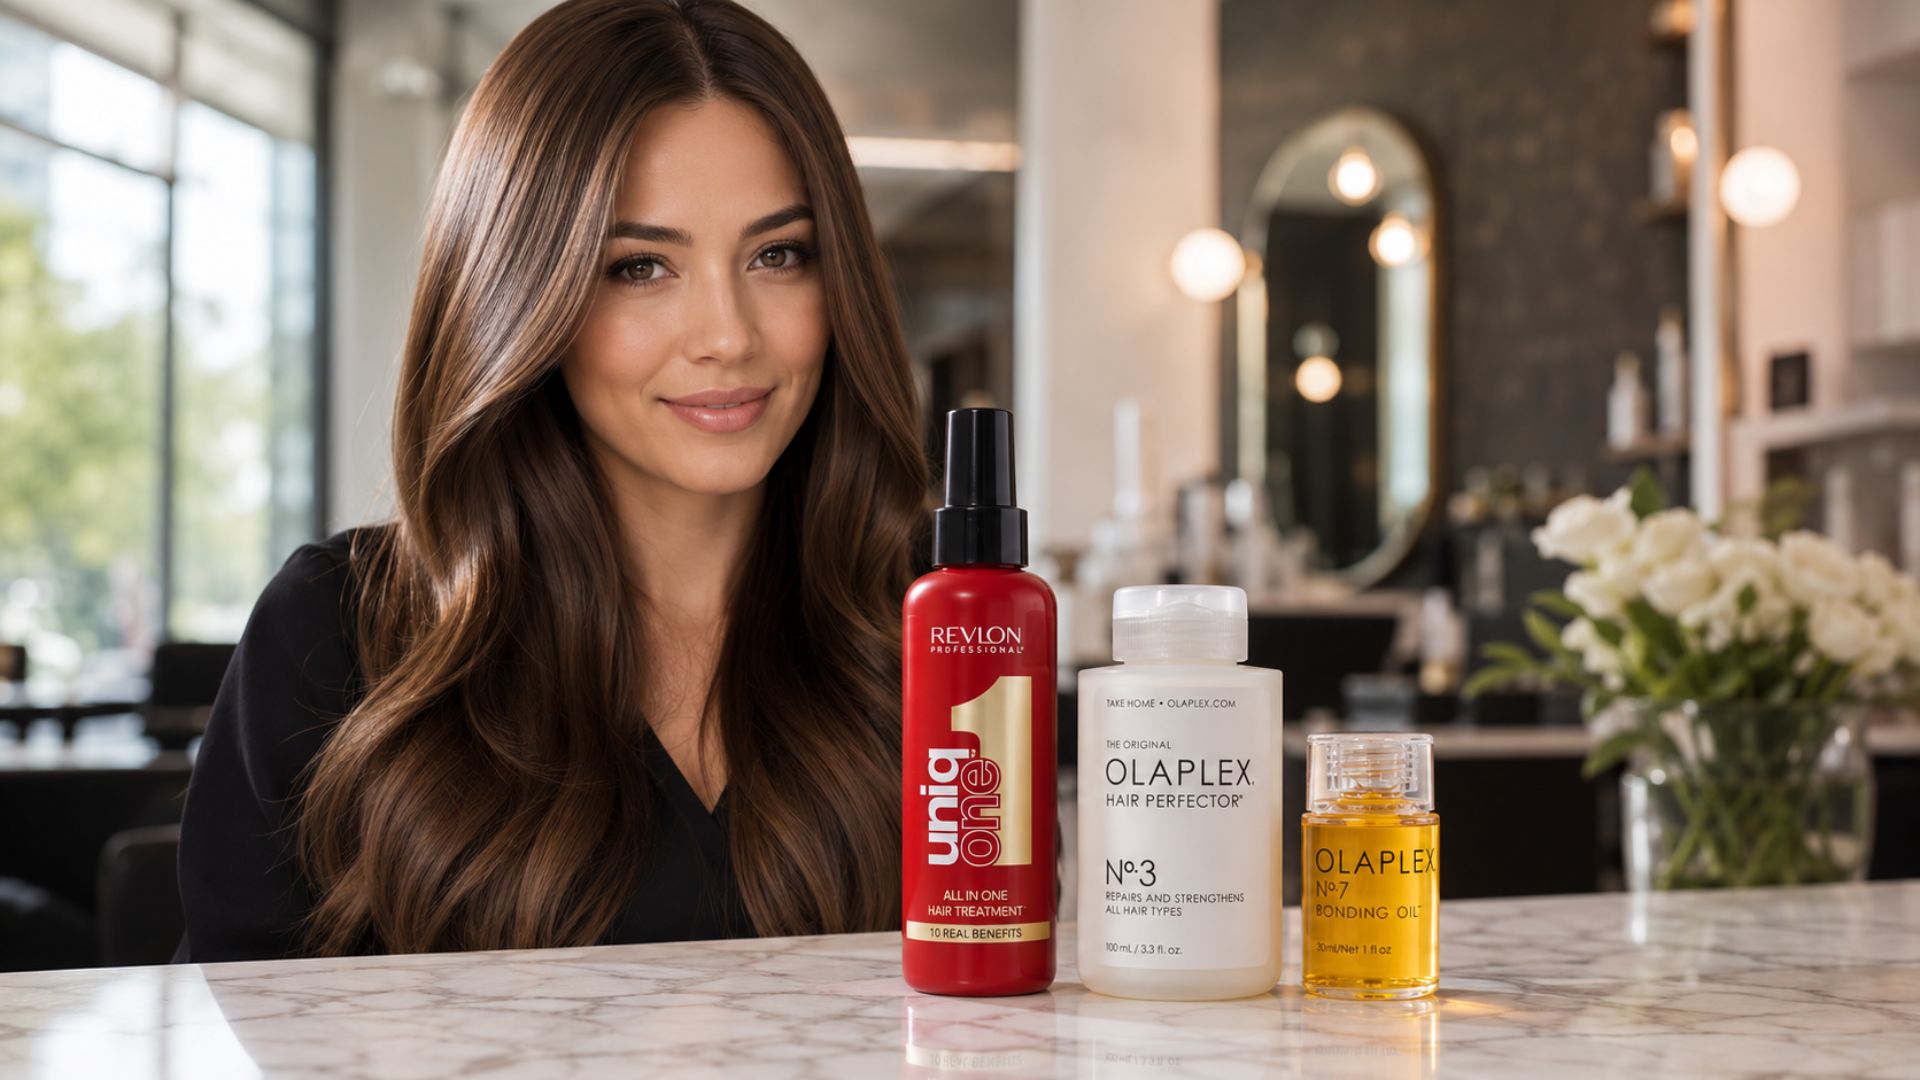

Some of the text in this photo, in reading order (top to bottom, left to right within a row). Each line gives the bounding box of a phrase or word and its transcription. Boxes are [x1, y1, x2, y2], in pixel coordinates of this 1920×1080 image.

[931, 626, 1021, 645] REVLON
[1106, 698, 1236, 709] TAKE HOME OLAPLEX.COM
[1106, 740, 1172, 749] THE ORIGINAL
[920, 748, 970, 865] uniq
[1106, 794, 1139, 807] HAIR
[960, 758, 1001, 867] one
[1316, 848, 1436, 875] OLAPLEX
[943, 889, 1008, 901] ALL IN ONE
[1105, 891, 1245, 903] REPAIRS AND STRENGTHENS
[928, 905, 1023, 917] HAIR TREATMENT
[1105, 905, 1182, 916] ALL HAIR TYPES
[1316, 904, 1389, 919] BONDING
[930, 928, 1022, 939] 10 REAL BENEFITS
[1141, 944, 1155, 954] 3.3
